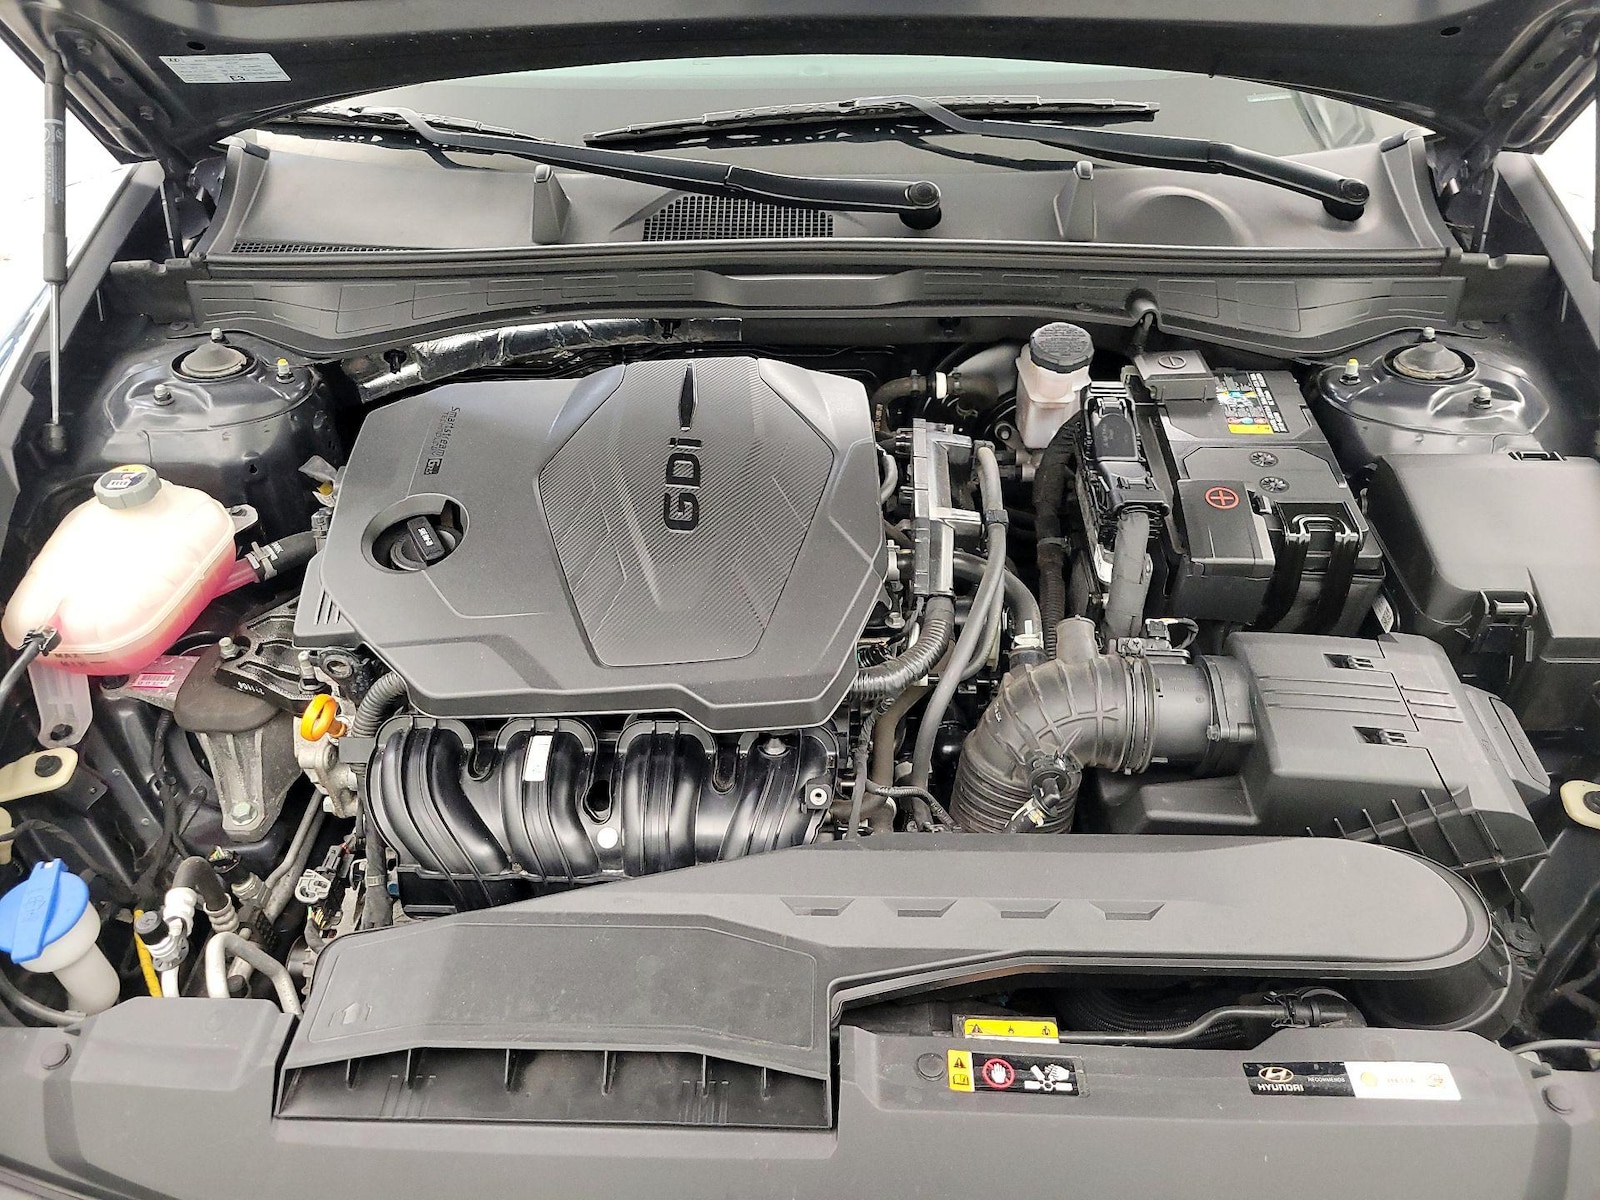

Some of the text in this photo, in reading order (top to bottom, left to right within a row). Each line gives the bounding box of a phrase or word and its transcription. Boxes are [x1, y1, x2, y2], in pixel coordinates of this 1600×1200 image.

[438, 406, 461, 457] Smartstream
[664, 437, 702, 531] GDi
[1257, 1083, 1305, 1092] HYUNDAI
